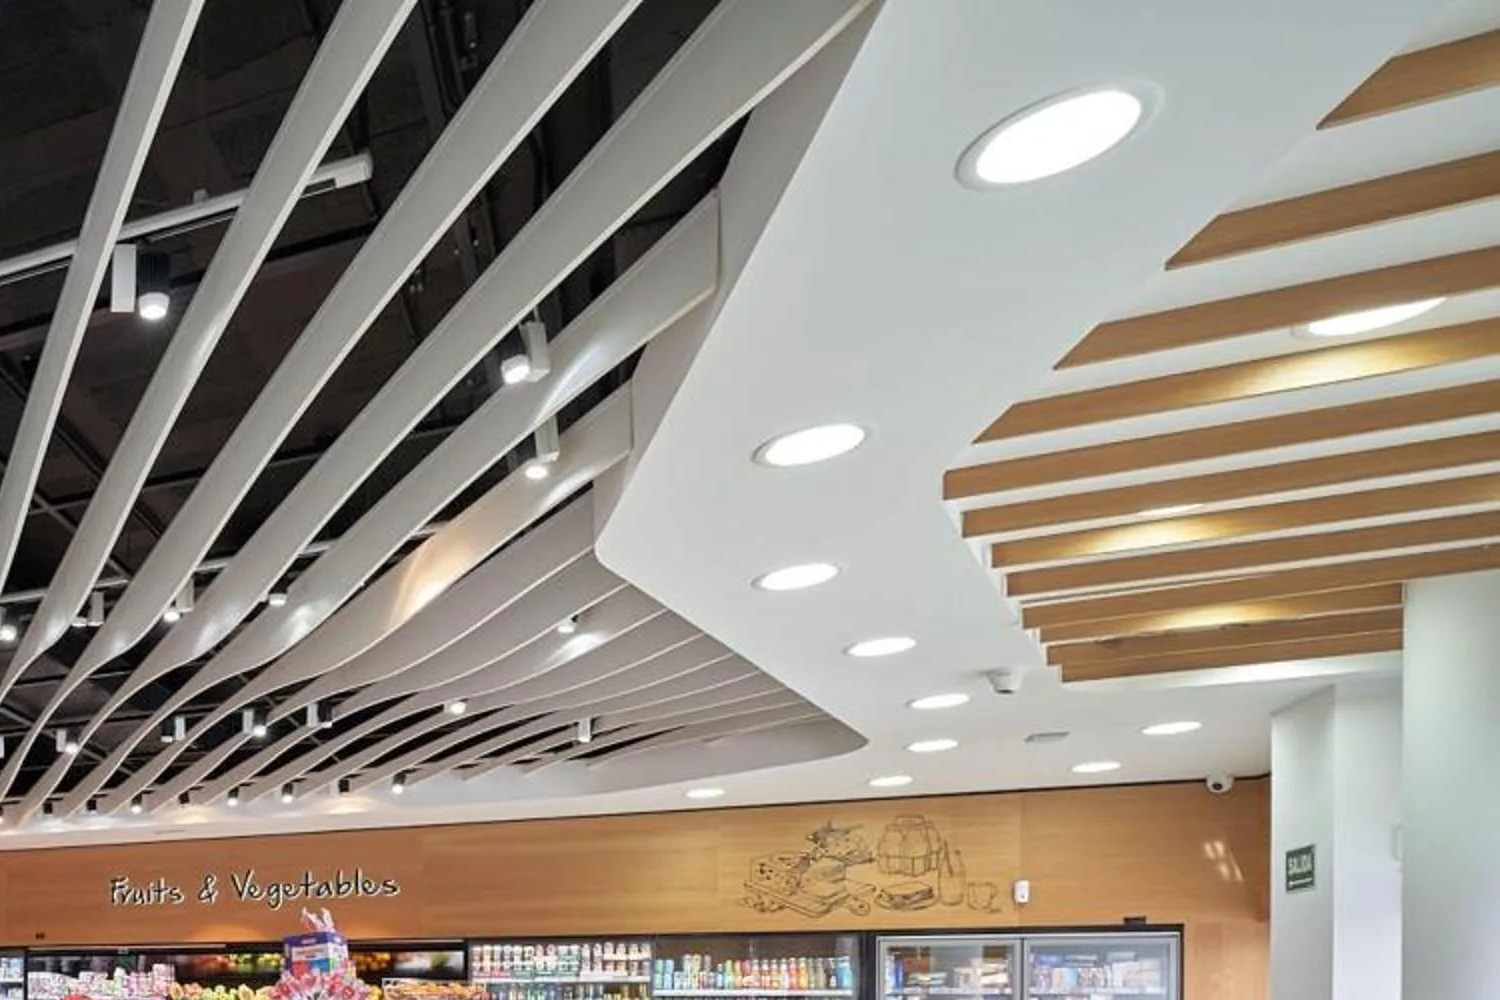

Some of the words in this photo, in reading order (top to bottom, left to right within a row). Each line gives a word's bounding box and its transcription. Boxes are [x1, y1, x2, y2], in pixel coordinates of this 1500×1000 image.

[1287, 854, 1312, 876] SALIDA
[110, 874, 185, 905] Fruits
[198, 874, 217, 904] &
[231, 868, 400, 910] Vegetables
